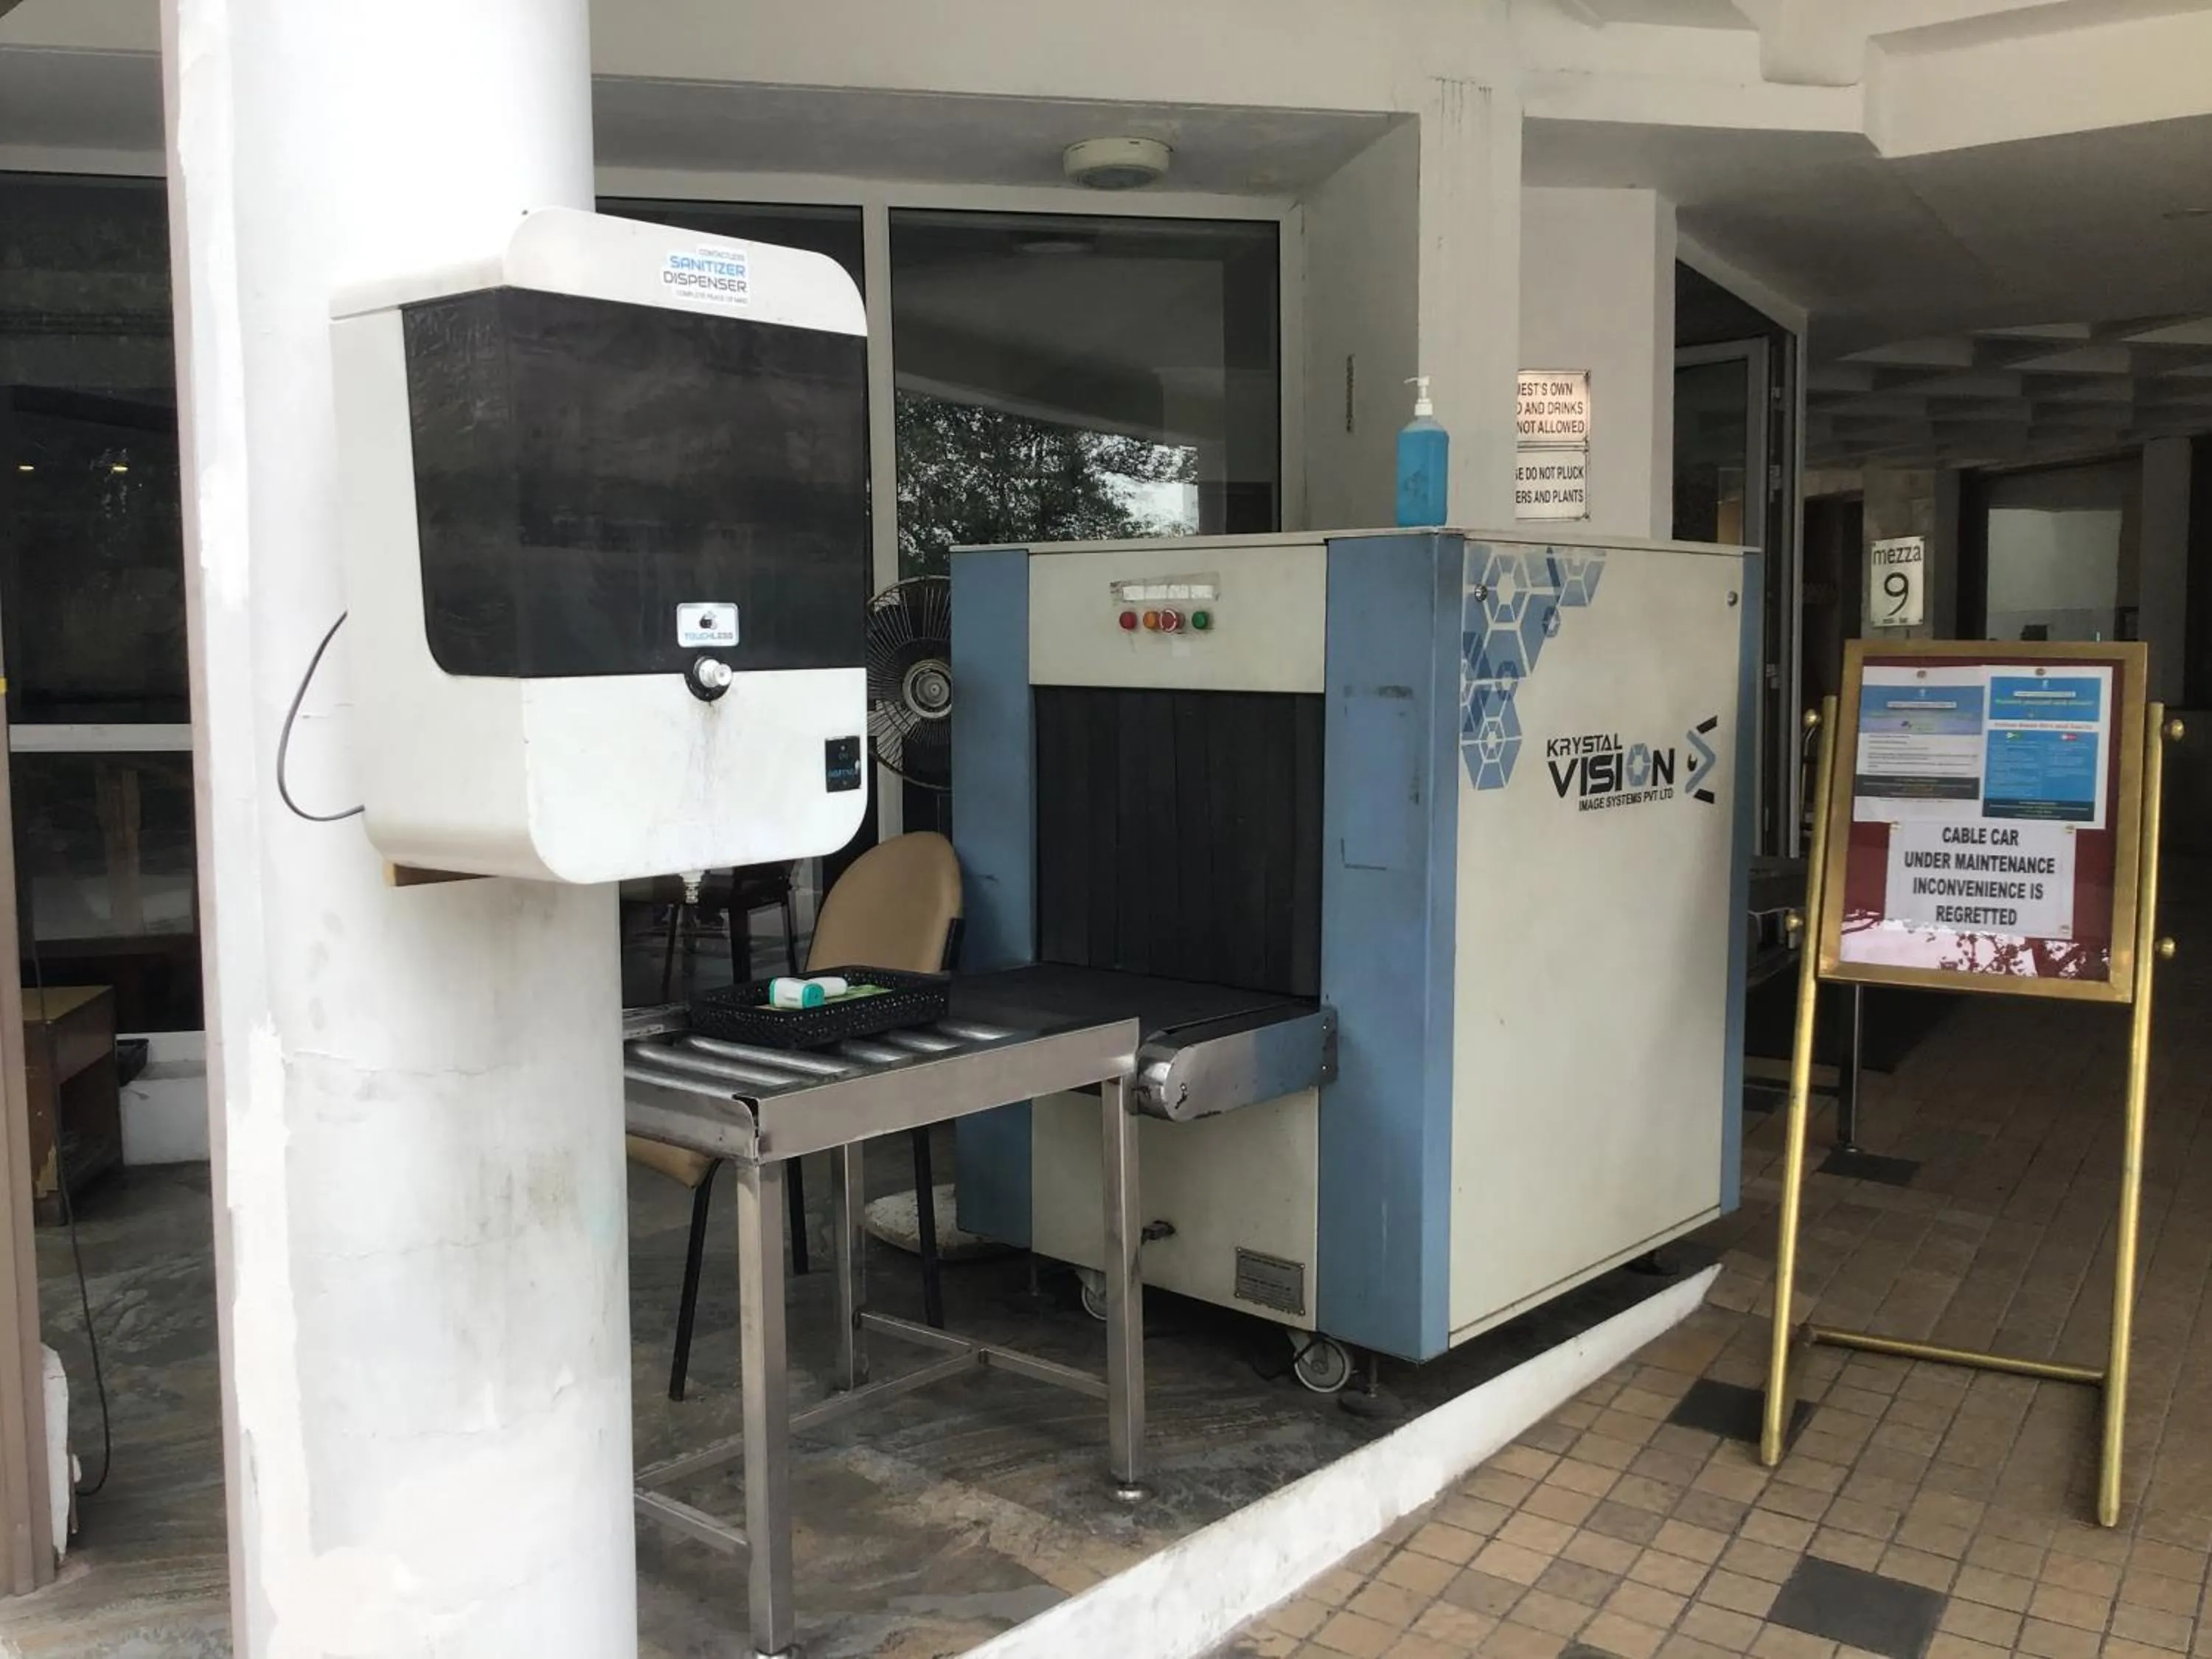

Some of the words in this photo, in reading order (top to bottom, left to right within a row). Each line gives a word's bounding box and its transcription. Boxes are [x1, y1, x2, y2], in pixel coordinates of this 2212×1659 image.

[669, 255, 745, 278] SANITIZER
[663, 271, 748, 293] DISPENSER
[1550, 382, 1573, 396] OWN
[1525, 402, 1545, 415] AND
[1548, 402, 1584, 415] DRINKS
[1537, 420, 1585, 434] ALLOWED
[1526, 467, 1537, 481] DO
[1540, 467, 1556, 481] NOT
[1557, 465, 1585, 480] PLUCK
[1534, 490, 1551, 503] AND
[1553, 489, 1584, 503] PLANTS
[1874, 546, 1922, 566] mezza
[1884, 571, 1909, 616] 9
[684, 632, 734, 641] TOUCHLESS
[1547, 733, 1623, 757] KRYSTAL
[1547, 743, 1675, 799] VISION
[1579, 796, 1604, 812] IMAGE
[1606, 792, 1642, 808] SYSTEMS
[1644, 790, 1658, 803] PVT
[1660, 787, 1674, 800] LTD
[1942, 827, 1987, 844] CABLE
[1991, 828, 2019, 846] CAR
[1905, 851, 1950, 869] UNDER
[1955, 852, 2056, 874] MAINTENANCE
[1913, 877, 2026, 899] INCONVENIENCE
[2030, 883, 2044, 900] IS
[1935, 905, 2017, 925] REGRETTED
